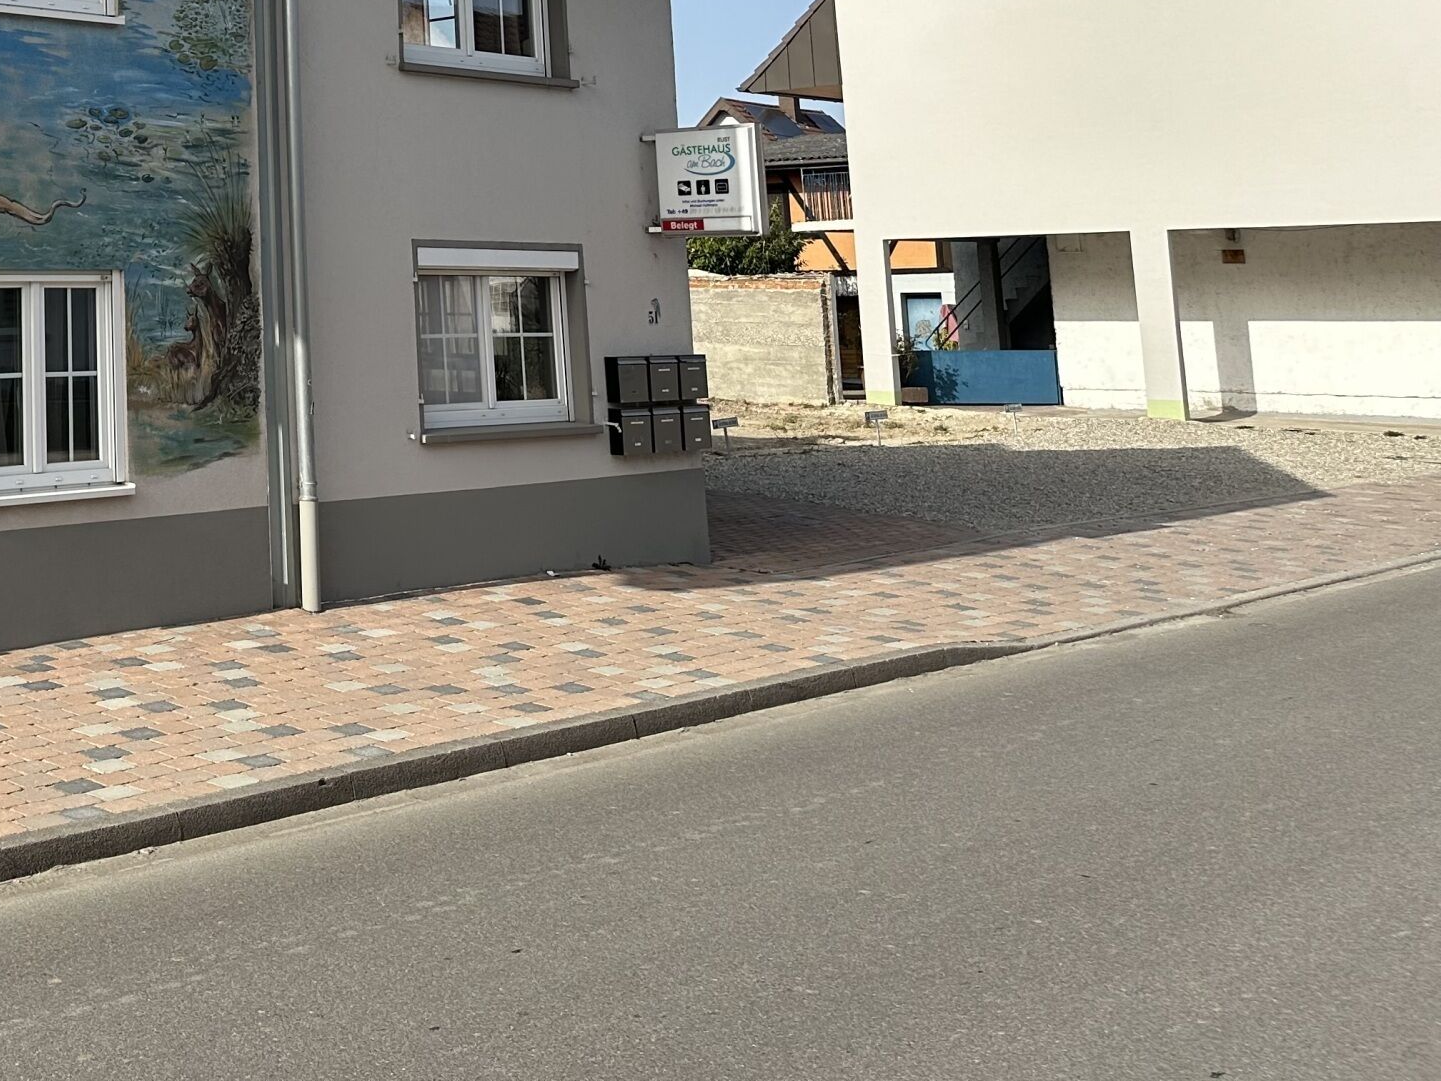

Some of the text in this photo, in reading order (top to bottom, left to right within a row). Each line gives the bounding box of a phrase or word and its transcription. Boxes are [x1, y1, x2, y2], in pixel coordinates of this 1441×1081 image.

[671, 143, 731, 156] GÄSTEHAUS
[686, 154, 725, 168] am Bach
[670, 221, 697, 230] Belegt
